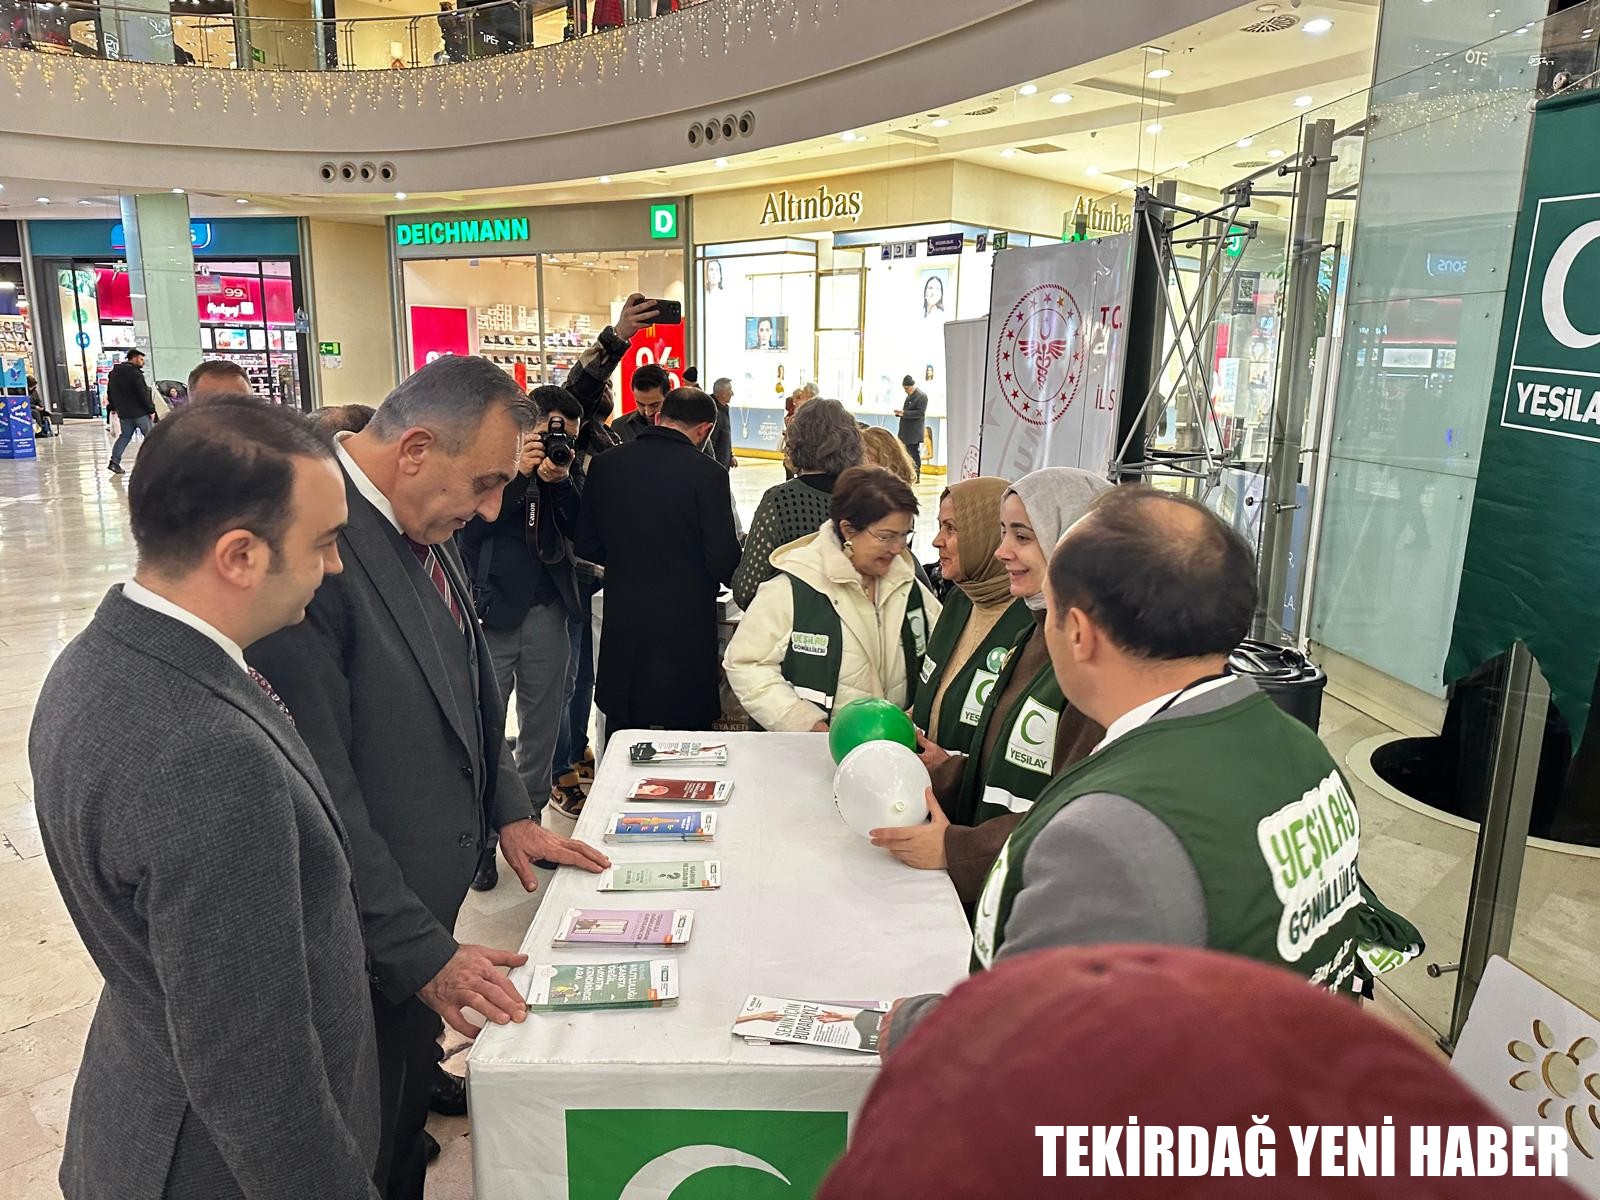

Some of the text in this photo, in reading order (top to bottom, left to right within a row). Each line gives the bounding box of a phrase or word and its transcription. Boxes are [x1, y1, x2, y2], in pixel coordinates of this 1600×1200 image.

[760, 186, 862, 223] Altınbaş
[397, 218, 528, 245] DEICHMANN
[655, 210, 673, 233] D
[528, 502, 536, 527] Canon
